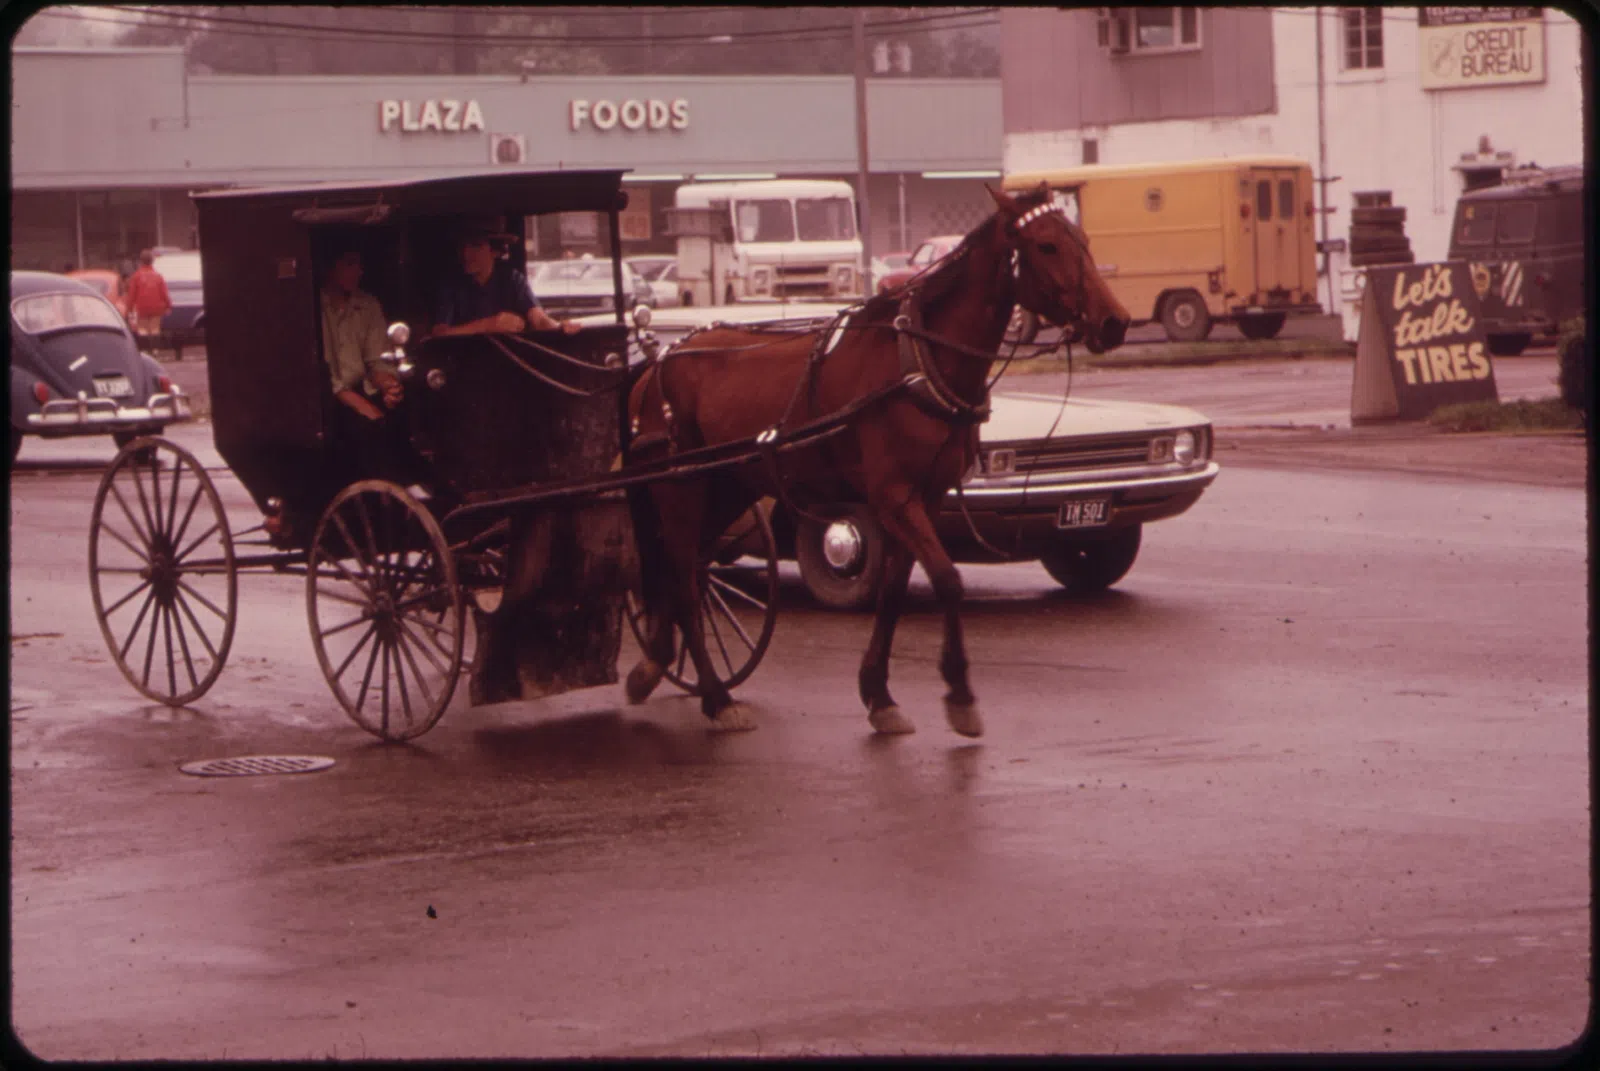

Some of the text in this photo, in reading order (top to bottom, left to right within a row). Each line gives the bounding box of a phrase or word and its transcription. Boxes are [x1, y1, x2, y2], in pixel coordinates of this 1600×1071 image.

[1464, 27, 1527, 52] CREDIT
[1461, 52, 1532, 78] BUREAU
[379, 98, 690, 132] PLAZA FOODS
[1392, 263, 1453, 311] Let's
[1393, 298, 1475, 348] talk
[1395, 341, 1491, 385] TIRES
